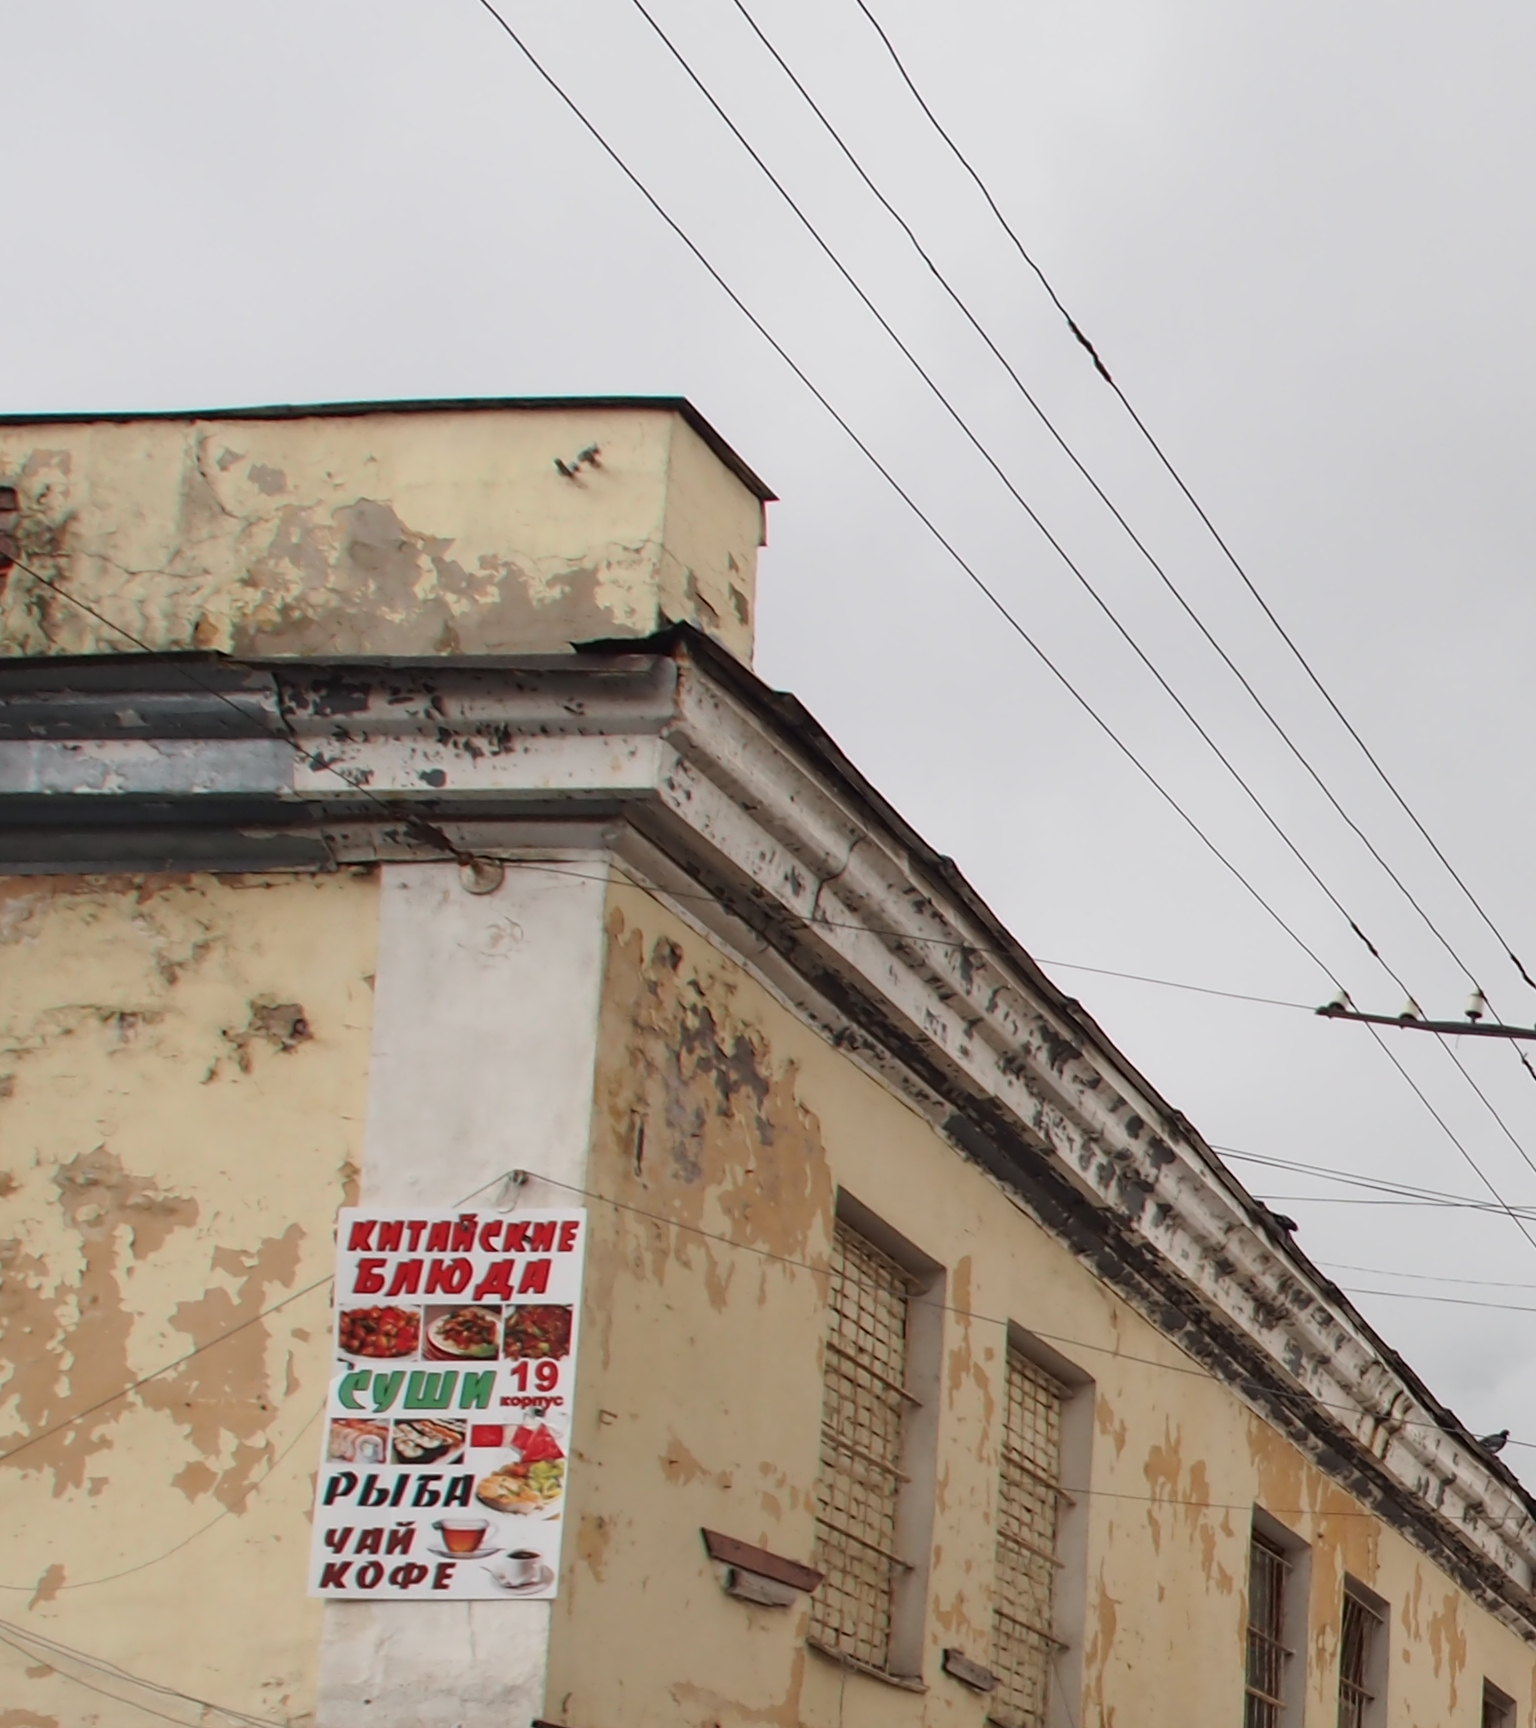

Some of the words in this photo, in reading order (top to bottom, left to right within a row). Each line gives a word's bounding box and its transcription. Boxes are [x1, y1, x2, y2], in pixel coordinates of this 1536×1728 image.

[347, 1213, 580, 1253] КИТАЙСКИЕ
[352, 1257, 553, 1301] БЛЮДА
[338, 1368, 497, 1413] СУШИ
[510, 1359, 560, 1392] 19
[499, 1393, 565, 1412] корпус
[323, 1471, 476, 1508] РЫБА
[324, 1520, 417, 1556] ЧАЙ
[318, 1561, 458, 1591] КОФЕ
